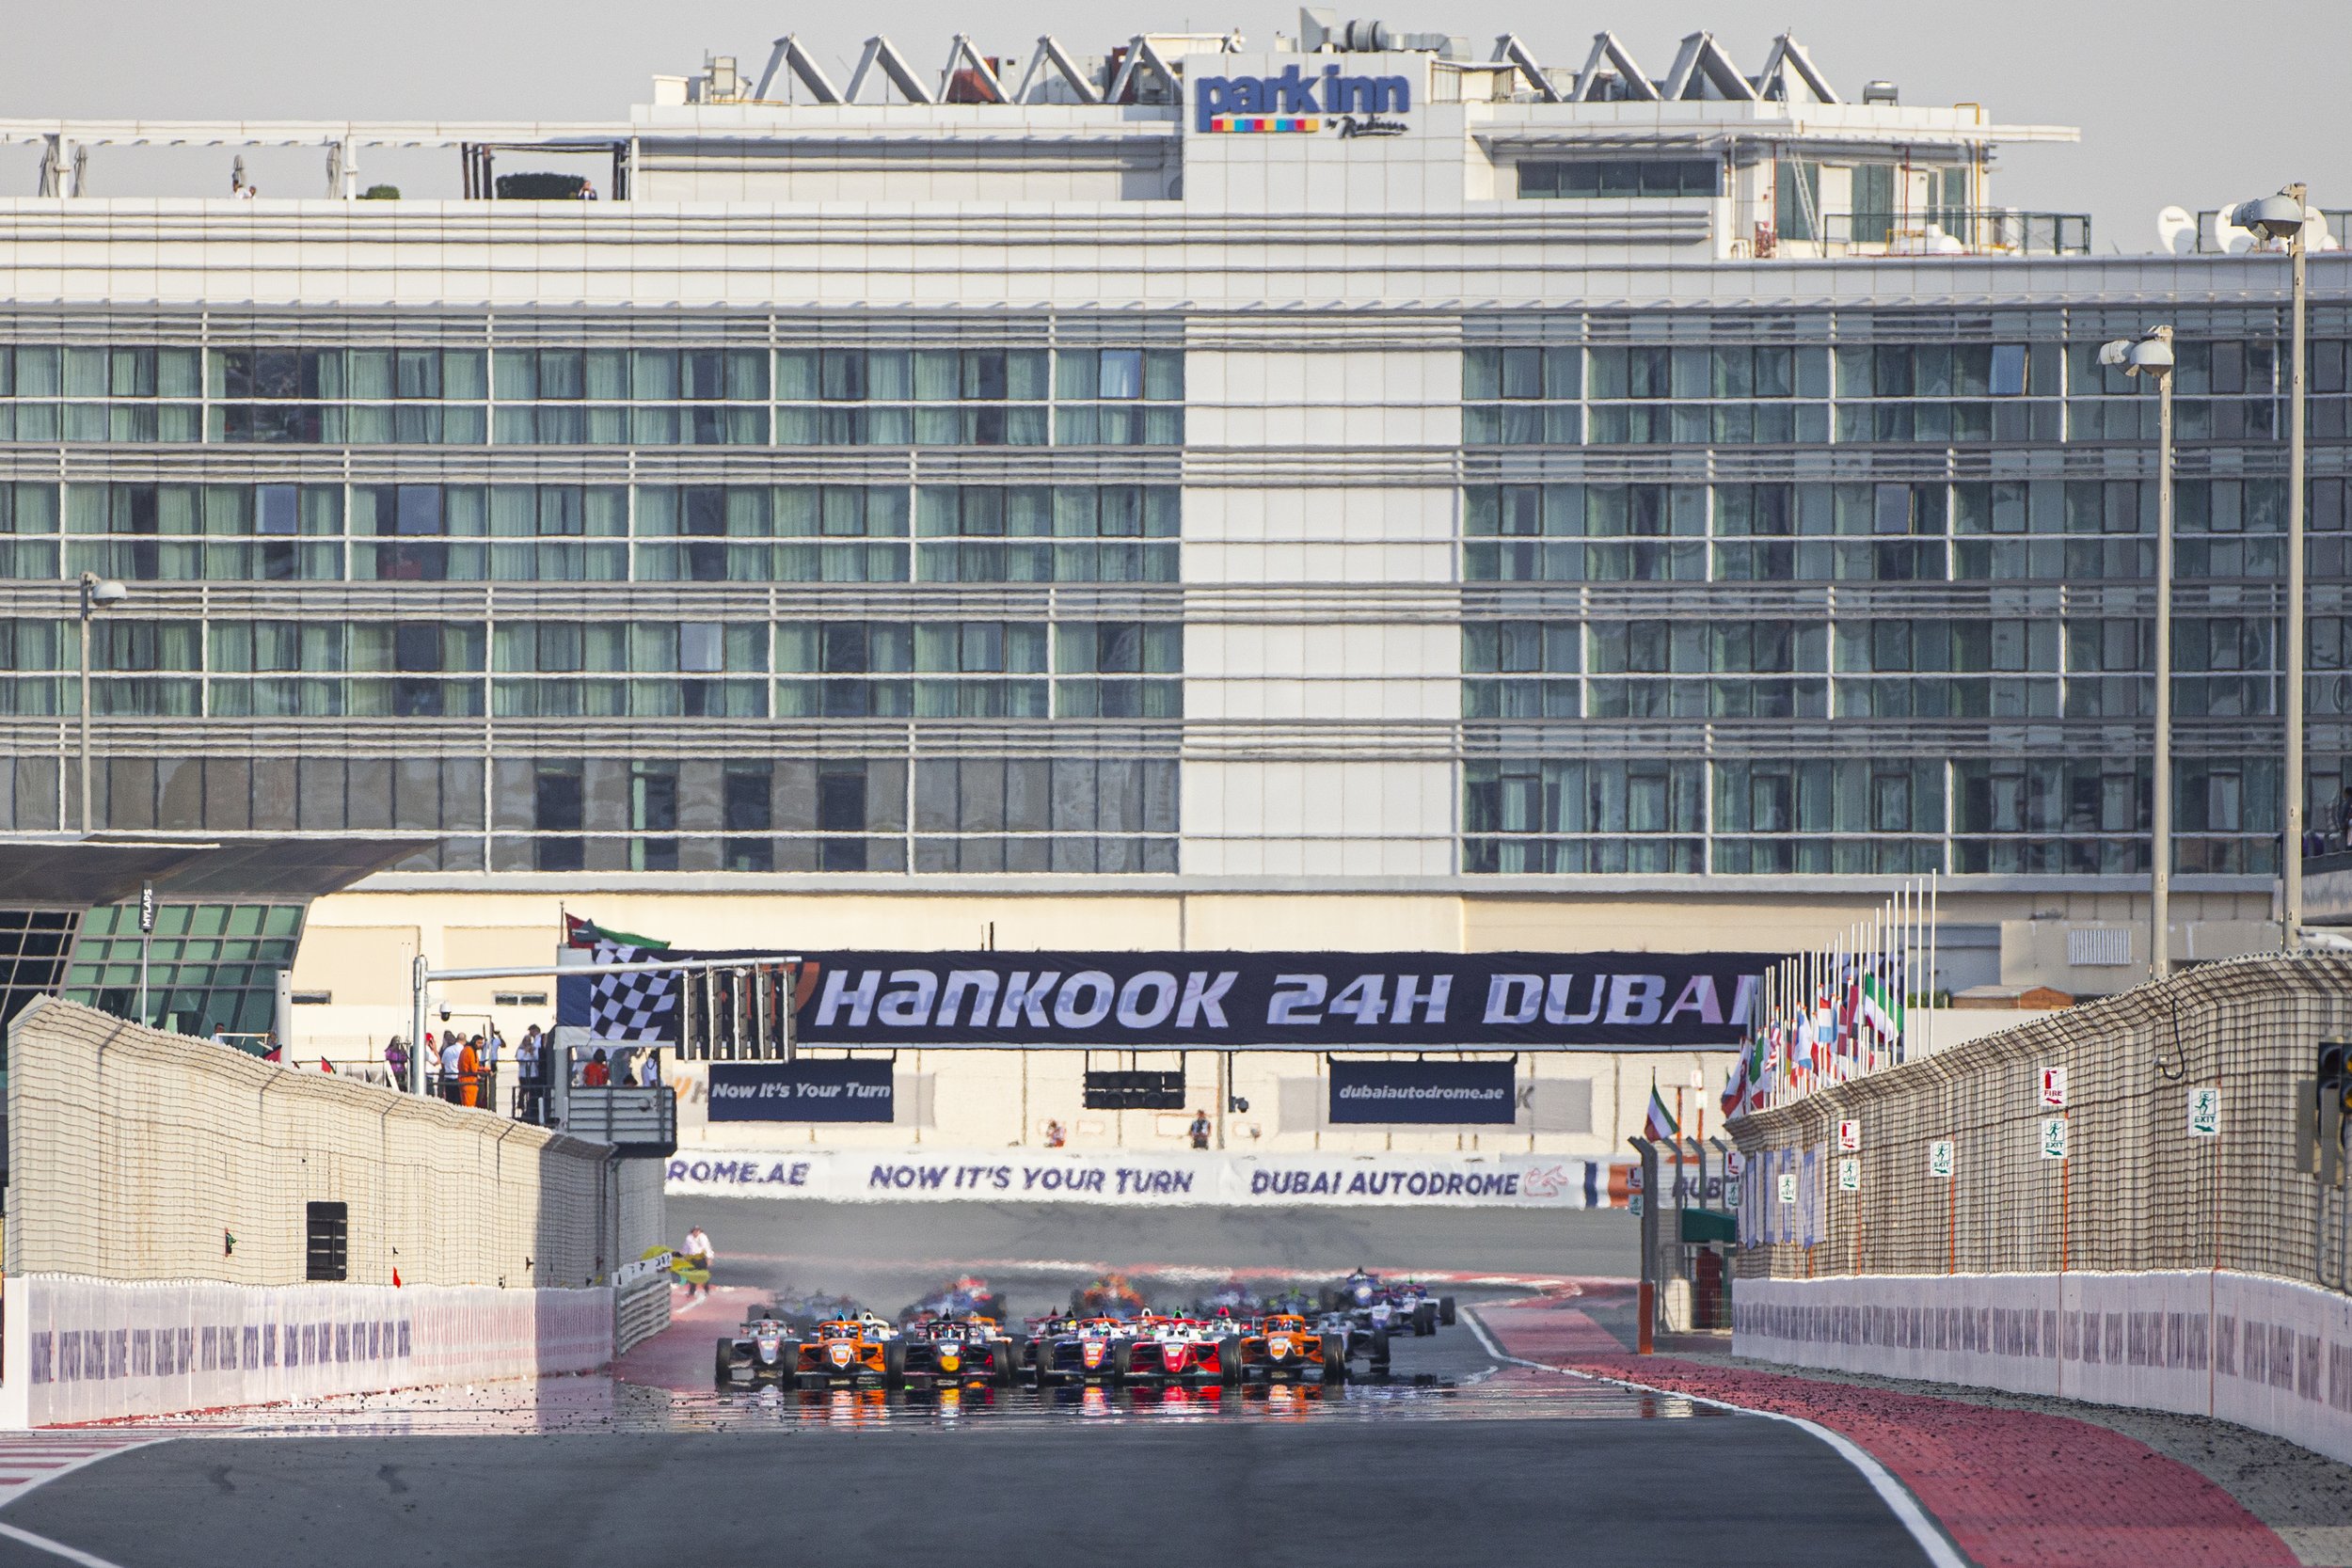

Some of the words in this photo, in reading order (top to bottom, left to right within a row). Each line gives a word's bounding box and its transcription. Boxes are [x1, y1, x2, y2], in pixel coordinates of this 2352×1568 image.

[1195, 64, 1321, 133] park
[1323, 64, 1410, 114] inn
[143, 889, 152, 927] MYLAPS
[1266, 974, 1454, 1024] 24H
[712, 1083, 756, 1099] Now
[758, 1083, 790, 1099] It's
[796, 1083, 842, 1099] Your
[846, 1082, 892, 1099] Turn
[1340, 1085, 1504, 1100] dubaiautodrome.ae
[868, 1165, 948, 1189] NOW
[954, 1165, 1011, 1190] IT'S
[1022, 1166, 1106, 1193] YOUR
[1115, 1167, 1195, 1195] TURN
[1250, 1169, 1343, 1196] DUBAI
[1346, 1171, 1520, 1196] AUTODROME
